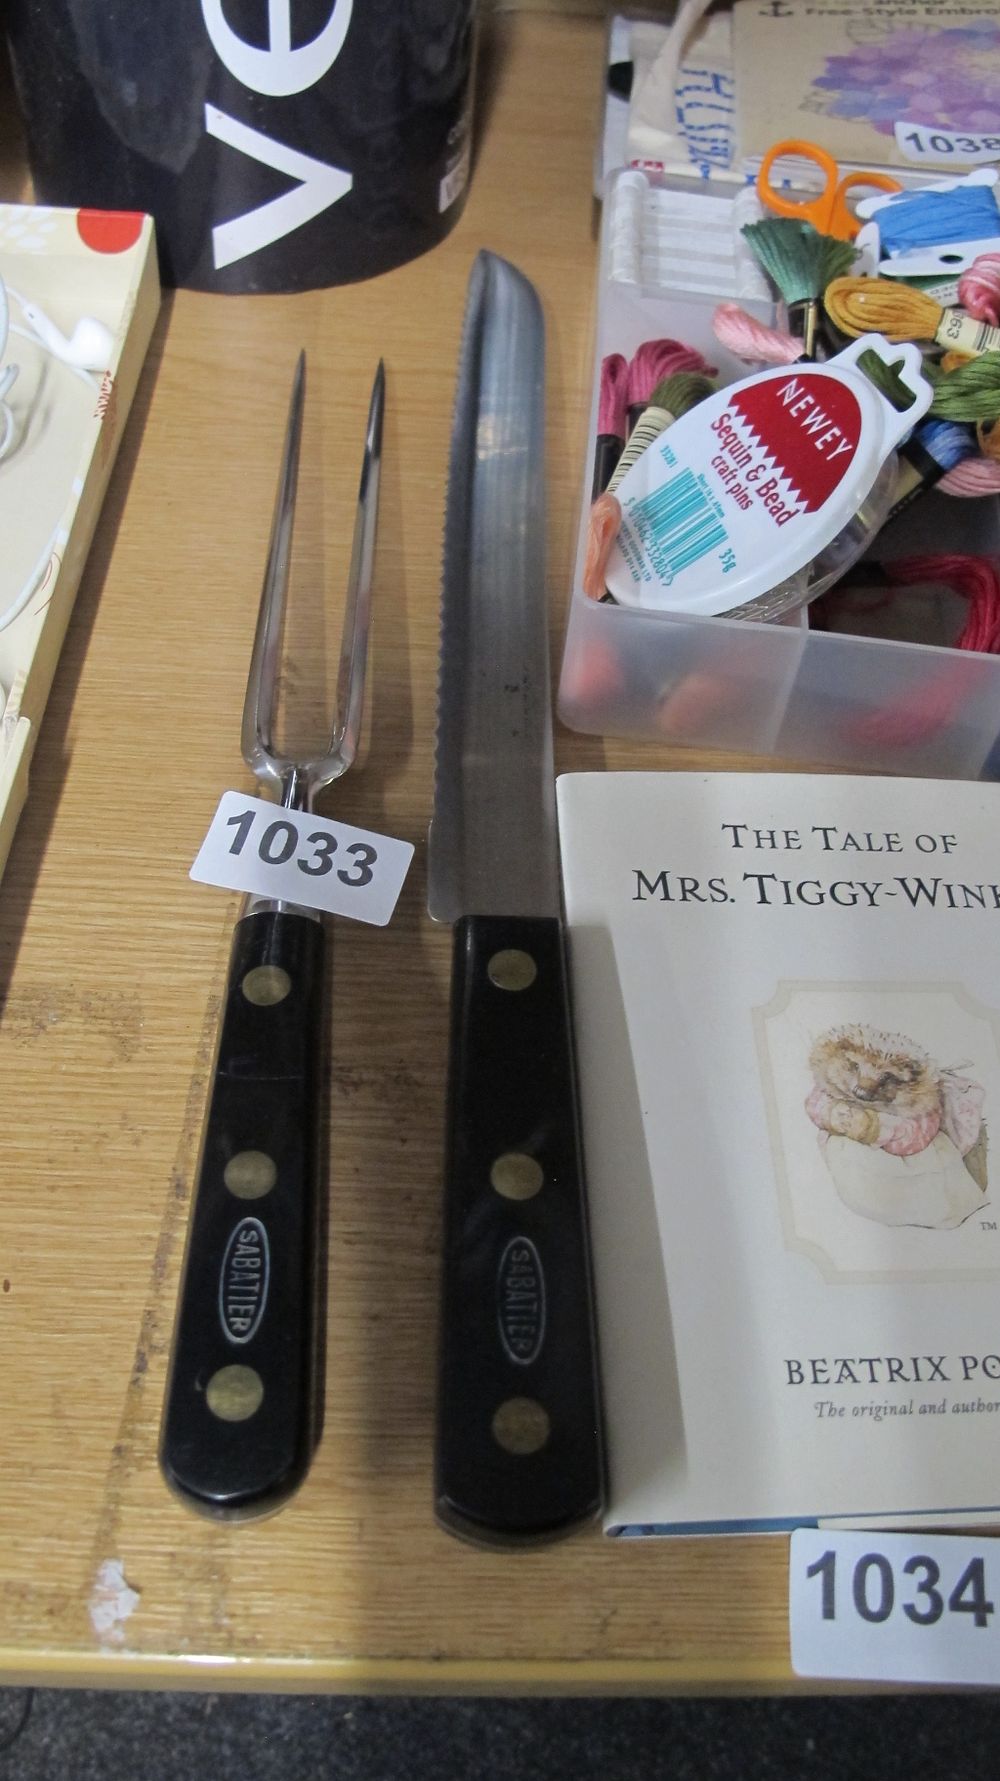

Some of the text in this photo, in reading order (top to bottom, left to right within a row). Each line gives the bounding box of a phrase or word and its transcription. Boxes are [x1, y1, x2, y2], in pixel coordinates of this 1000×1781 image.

[905, 132, 1000, 153] 1038
[776, 378, 853, 461] NEWEY
[710, 413, 801, 527] Sequin & Bead
[711, 455, 753, 511] craft pins
[718, 548, 737, 574] 35g
[226, 810, 378, 887] 1033
[228, 1230, 261, 1331] SABATIER
[505, 1249, 537, 1351] SABATIER
[784, 1355, 951, 1385] BEATRIX
[814, 1401, 845, 1418] The
[852, 1400, 913, 1421] original
[918, 1399, 947, 1415] and
[807, 1550, 994, 1627] 1034
